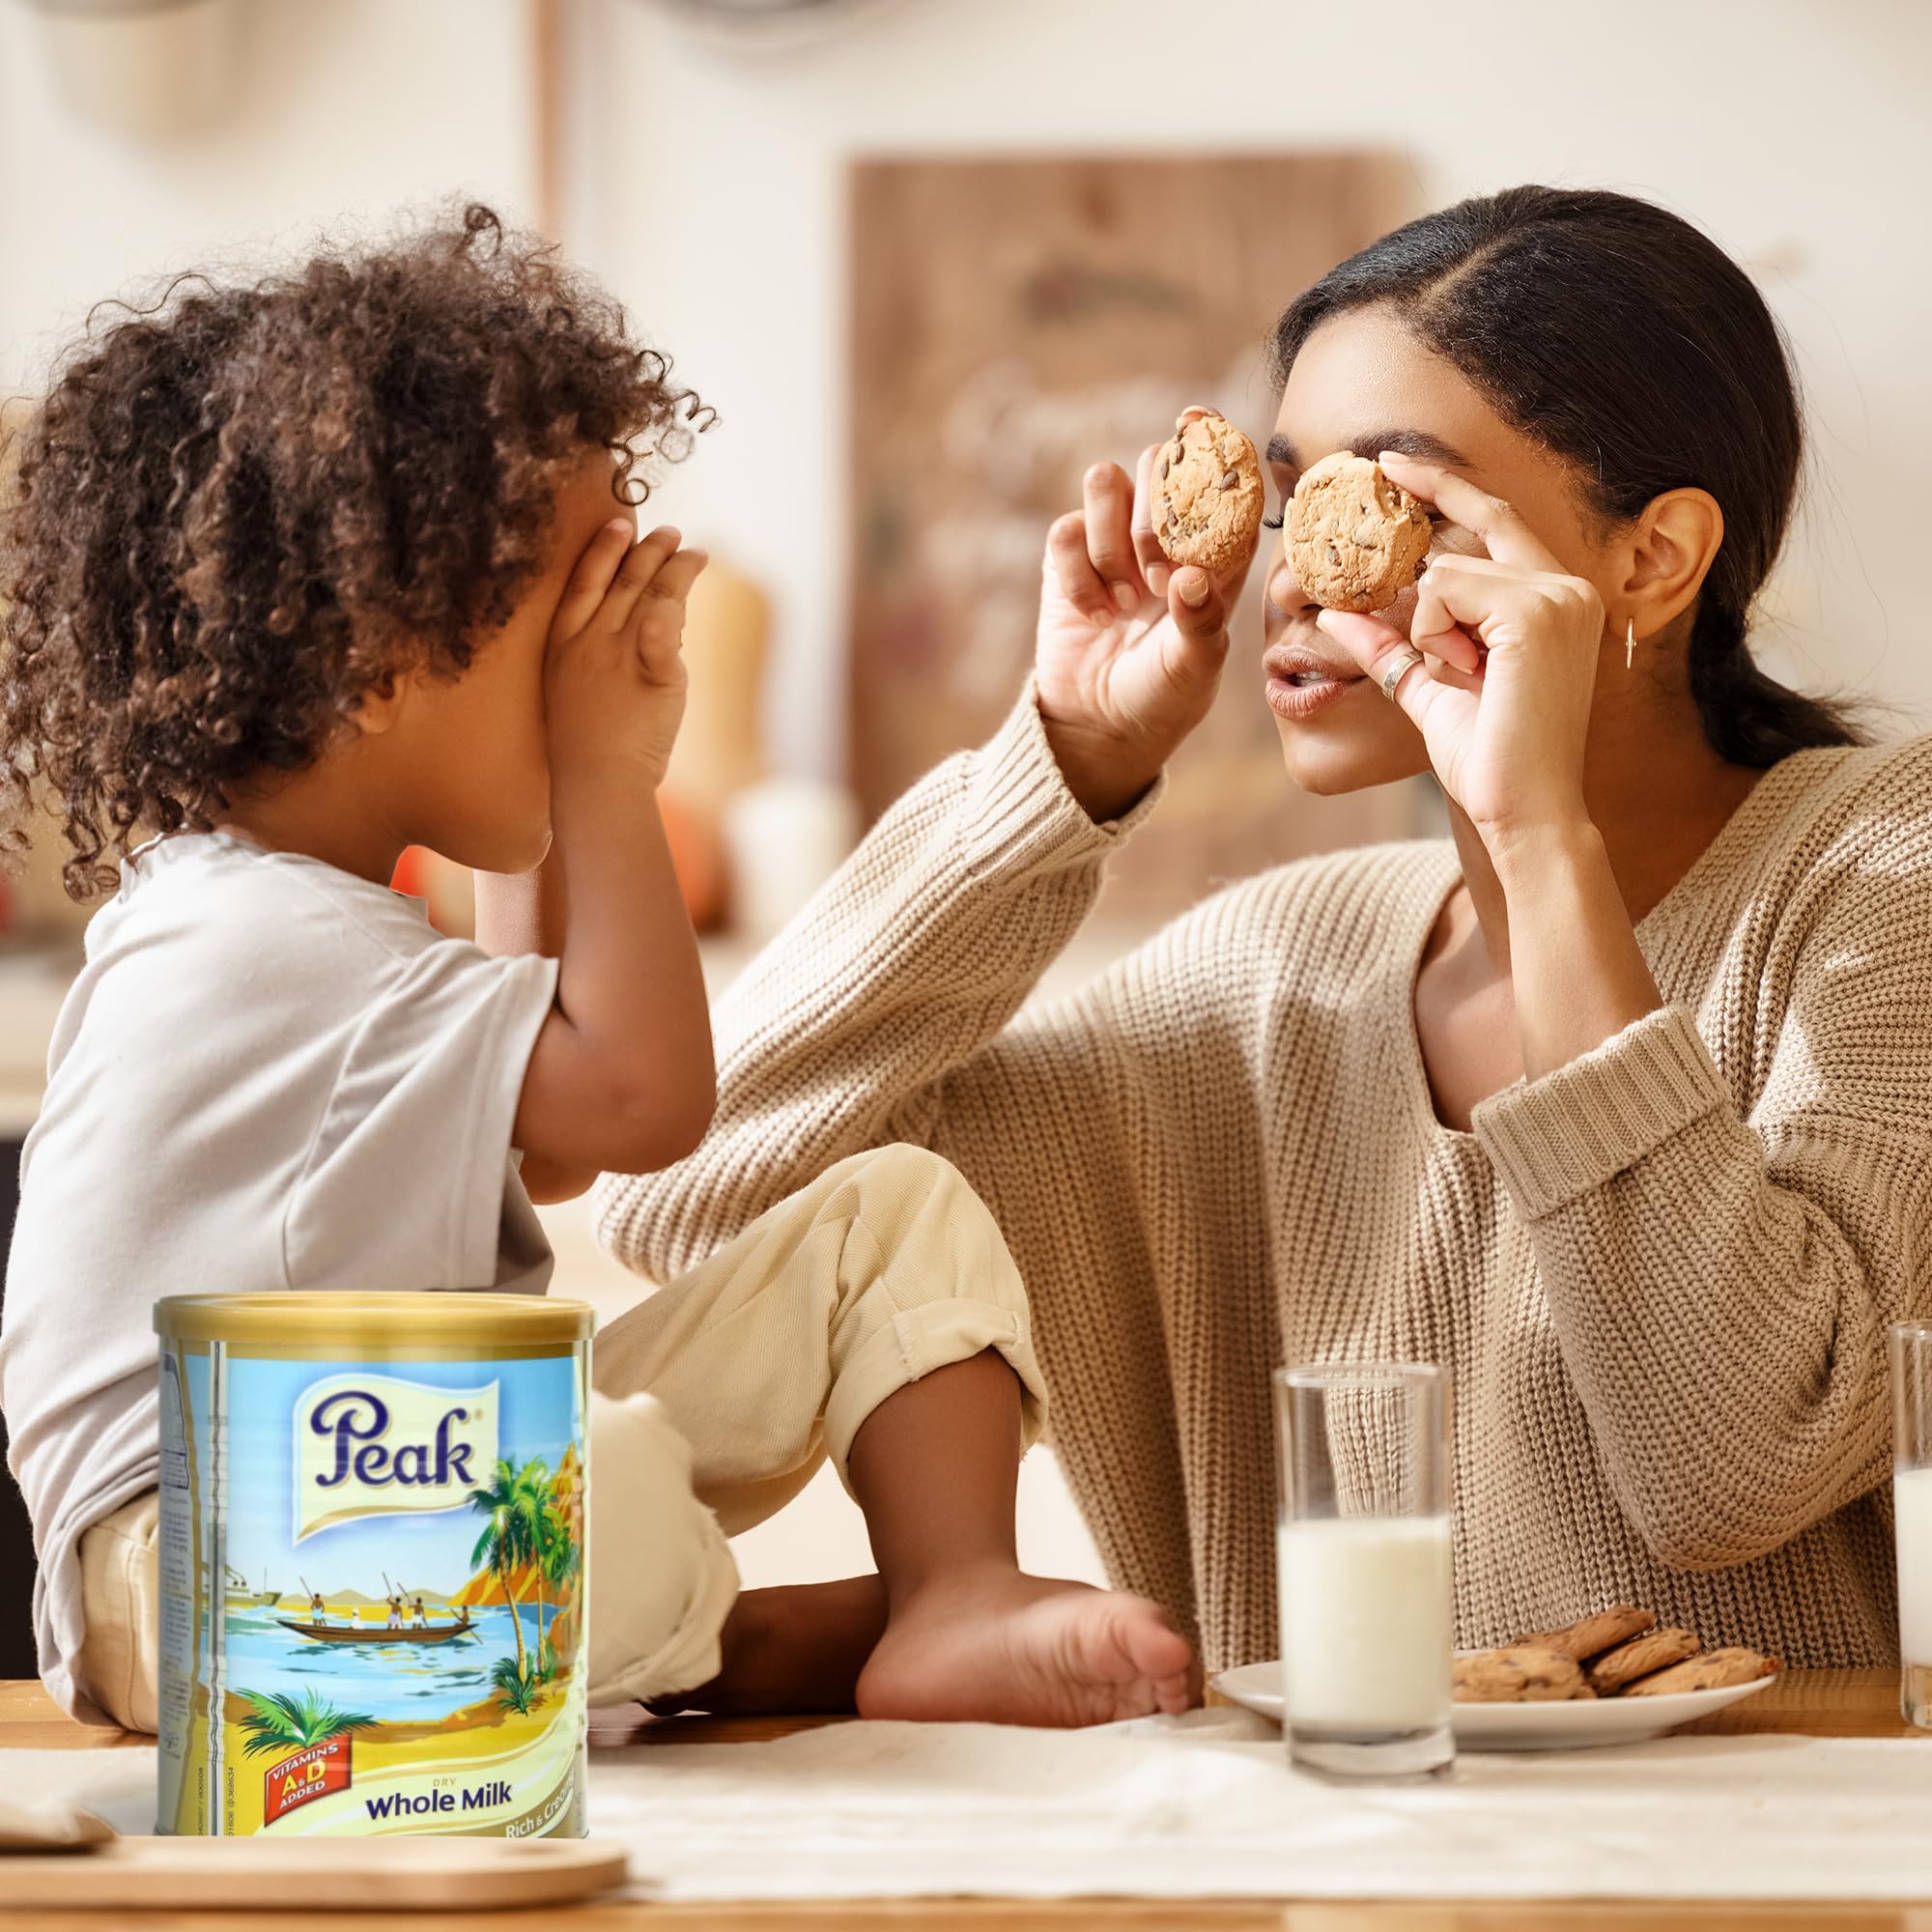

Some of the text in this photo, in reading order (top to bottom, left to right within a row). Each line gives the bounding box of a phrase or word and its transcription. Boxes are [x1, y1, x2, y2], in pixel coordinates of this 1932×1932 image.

[310, 1390, 477, 1488] Peak
[272, 1743, 339, 1780] VITAMINS
[281, 1758, 327, 1797] A & D
[279, 1780, 327, 1811] ADDED
[433, 1776, 457, 1787] DRY
[365, 1780, 513, 1821] Whole Milk
[505, 1817, 535, 1838] Rich
